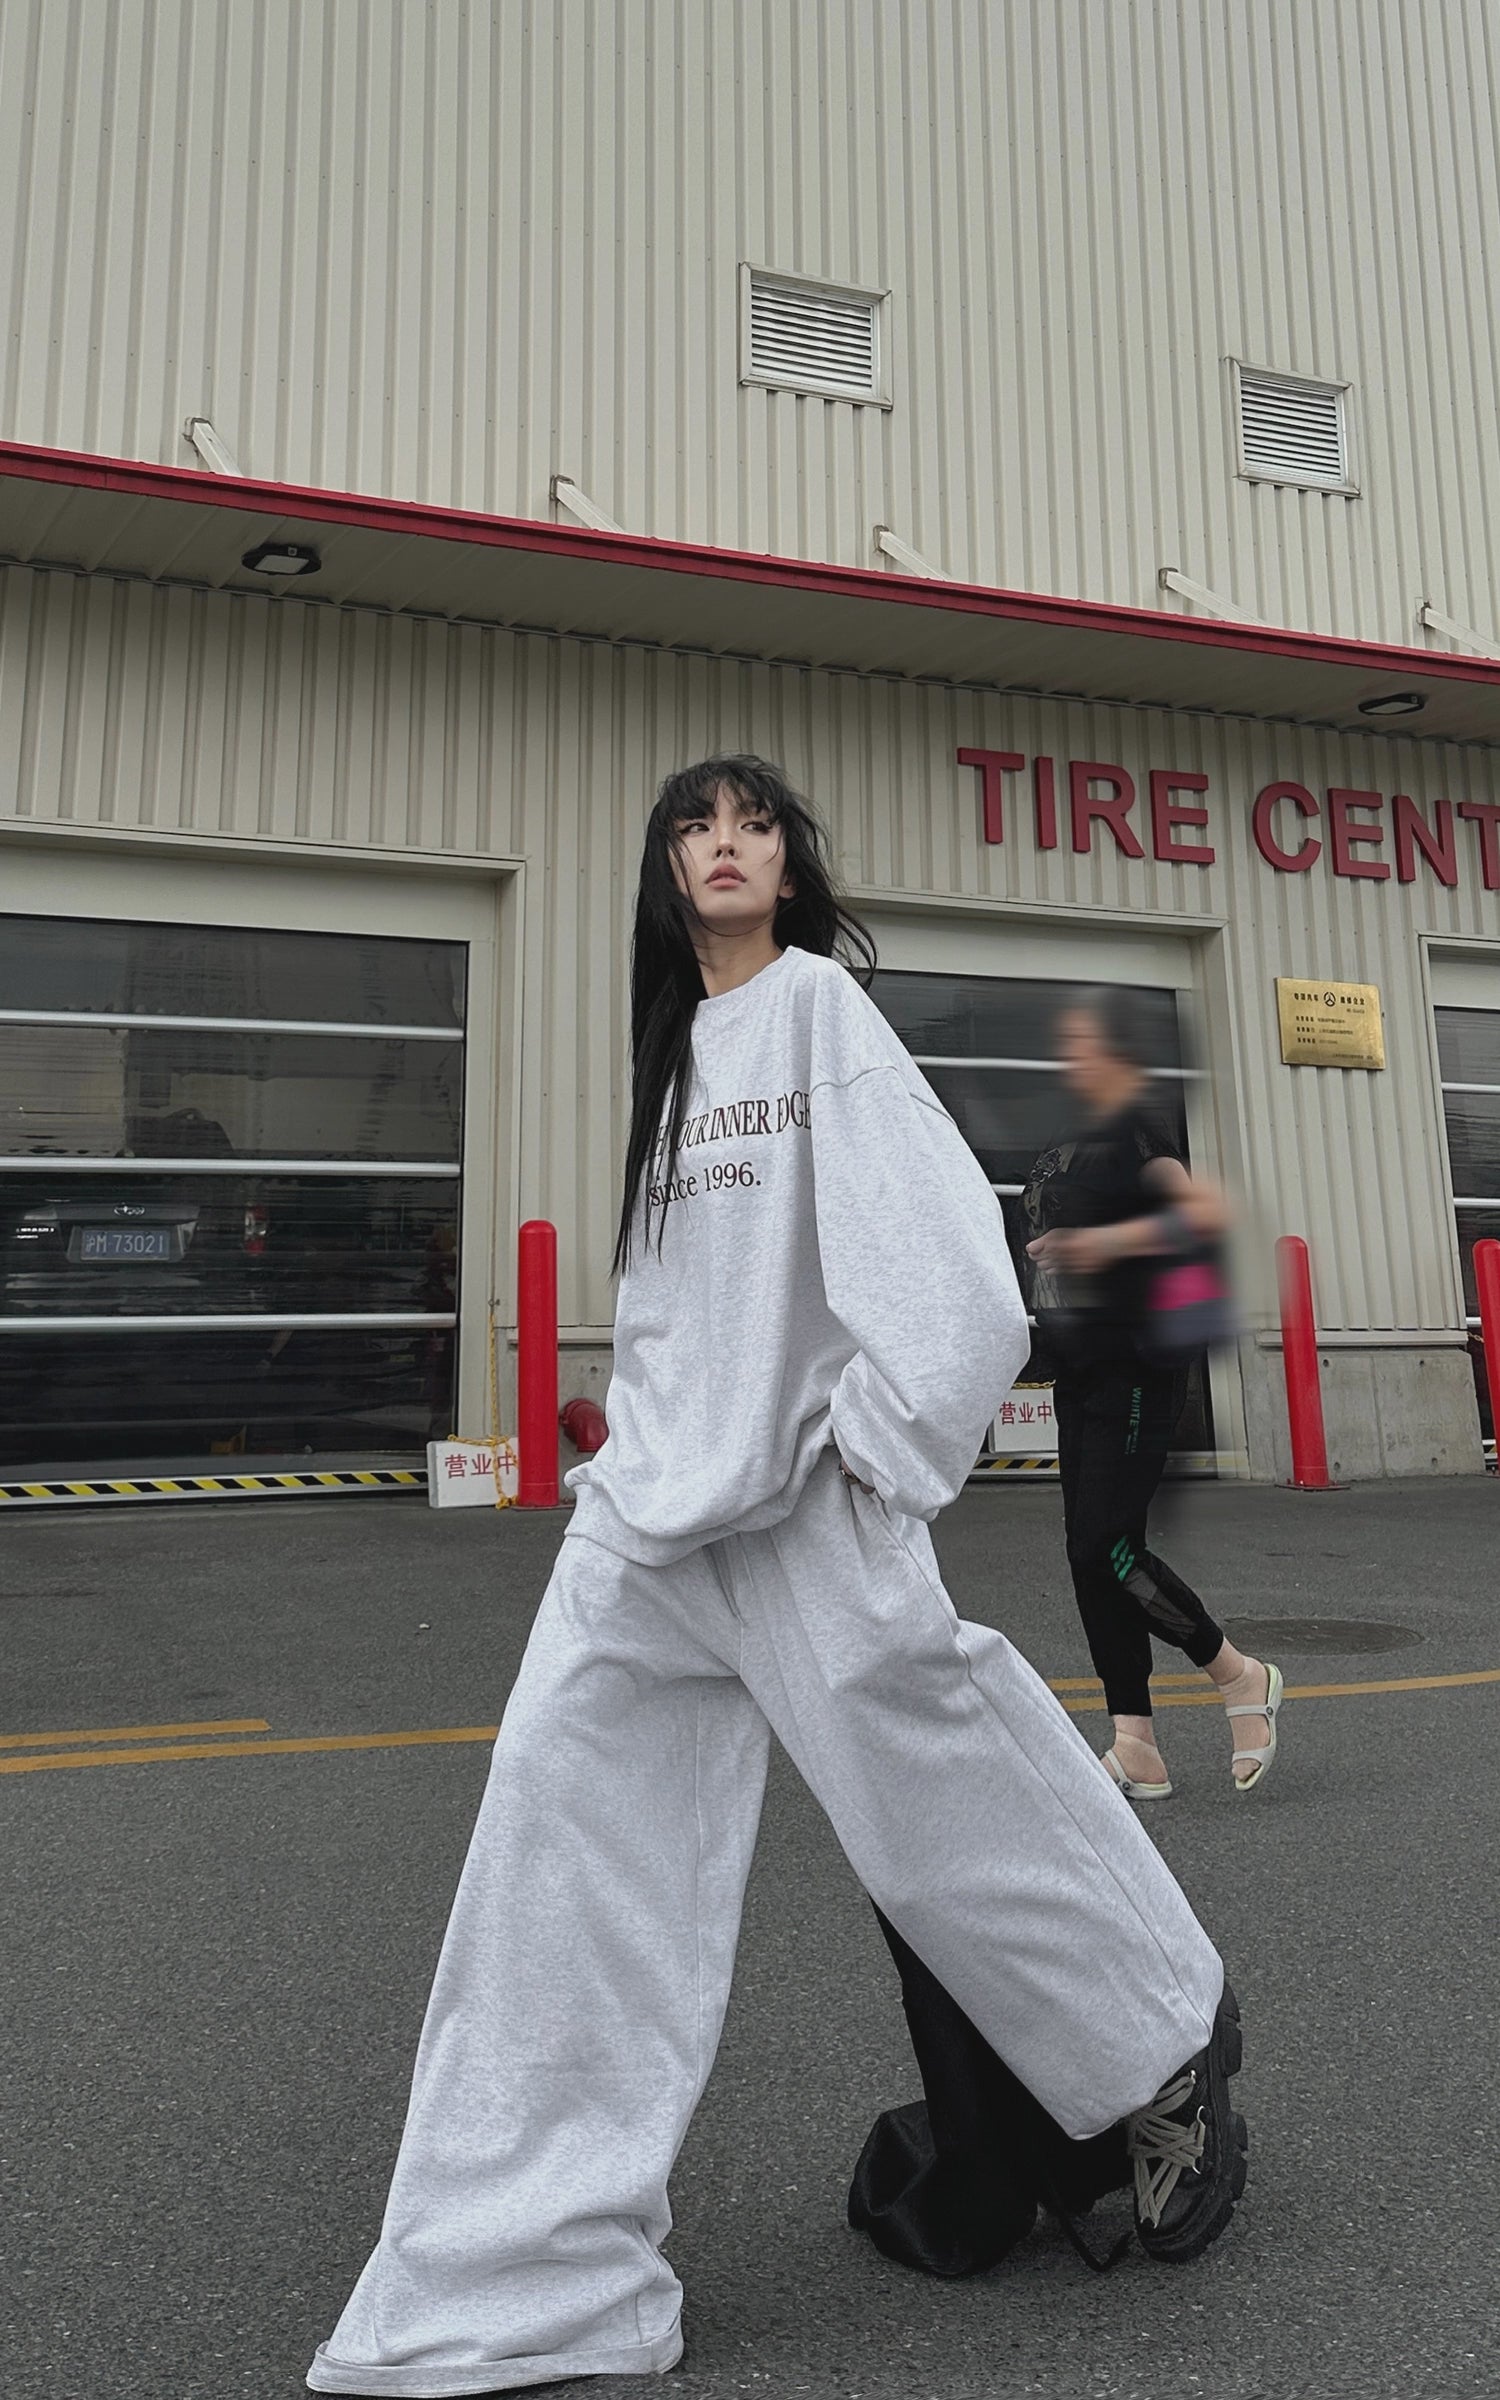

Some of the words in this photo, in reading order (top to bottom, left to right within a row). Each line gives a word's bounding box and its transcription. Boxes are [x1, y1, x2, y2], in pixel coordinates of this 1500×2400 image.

[956, 747, 1215, 864] TIRE
[1252, 780, 1500, 890] CENT
[708, 1099, 772, 1142] INNER
[650, 1175, 699, 1207] since
[703, 1161, 762, 1192] 1996.
[1000, 1401, 1052, 1426] 营业中
